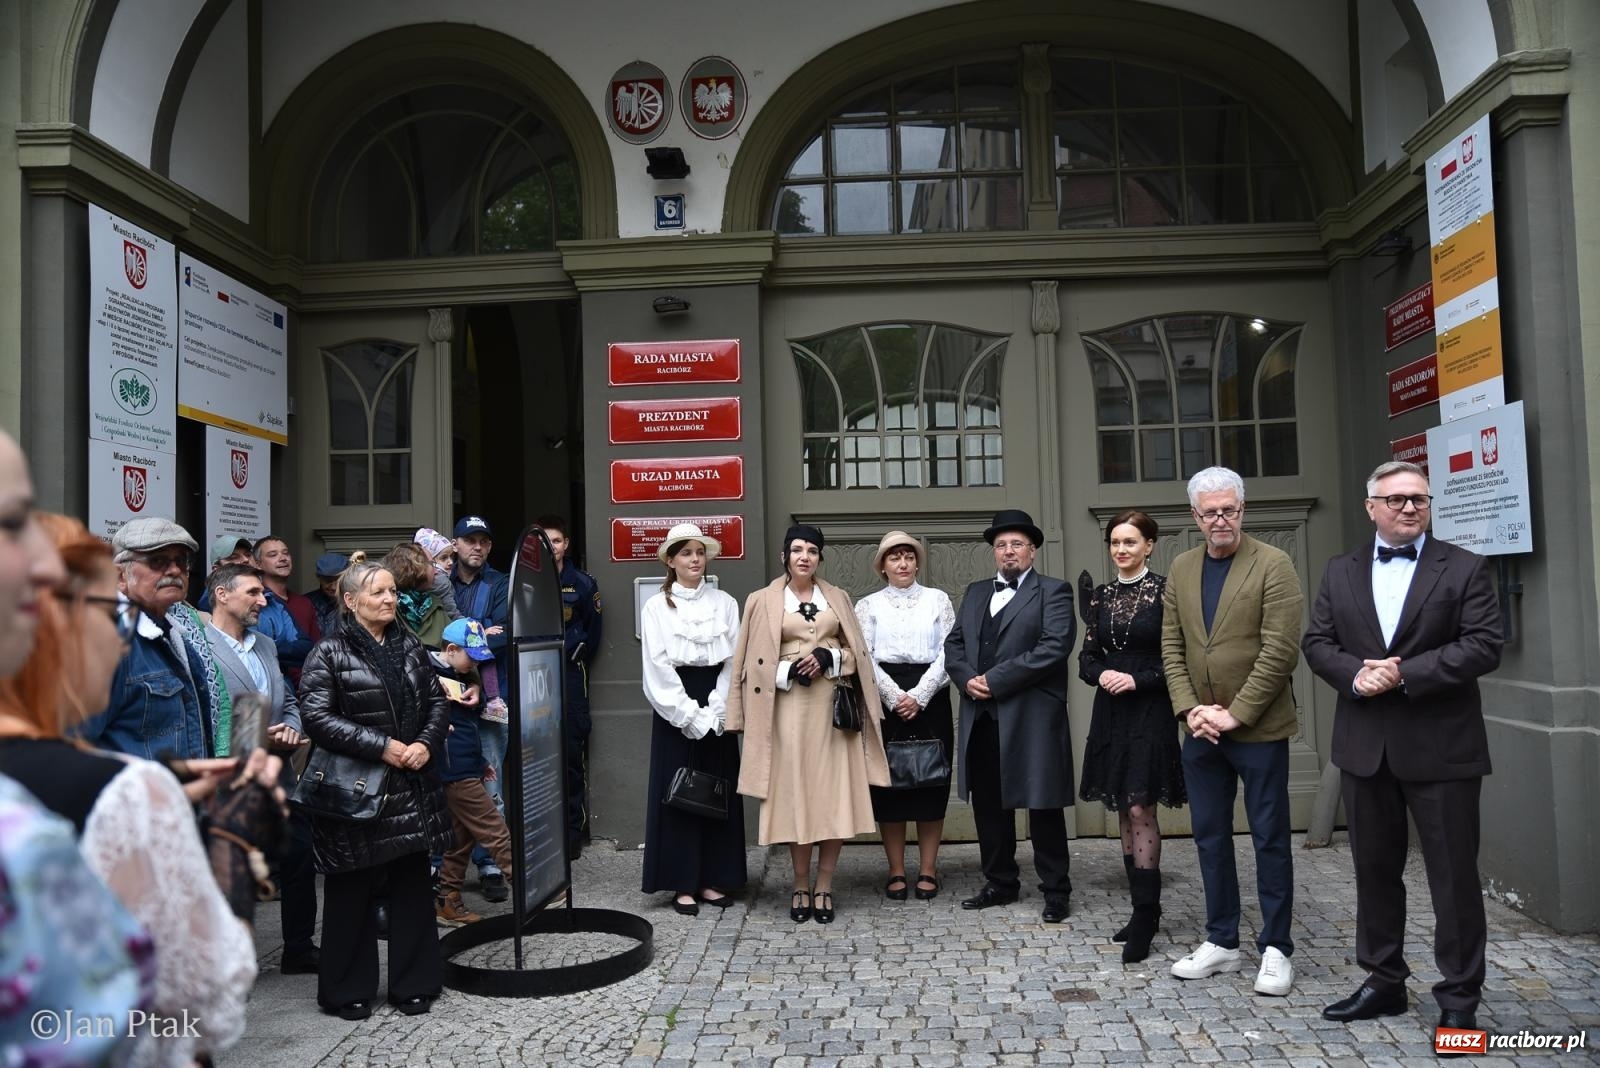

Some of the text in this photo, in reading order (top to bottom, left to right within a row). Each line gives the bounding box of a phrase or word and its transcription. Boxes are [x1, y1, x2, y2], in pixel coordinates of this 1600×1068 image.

[664, 200, 676, 218] 6
[113, 223, 156, 250] Miasto Racibórz
[1405, 304, 1424, 320] MIASTA
[634, 352, 714, 364] RADA MIASTA
[1392, 366, 1436, 392] RADA SENIORÓW
[638, 410, 710, 422] PREZYDENT
[113, 451, 156, 467] Miasto Racibórz
[631, 469, 720, 483] URZĄD MIASTA
[1508, 522, 1525, 531] POLSKI
[1508, 532, 1519, 540] ŁAD
